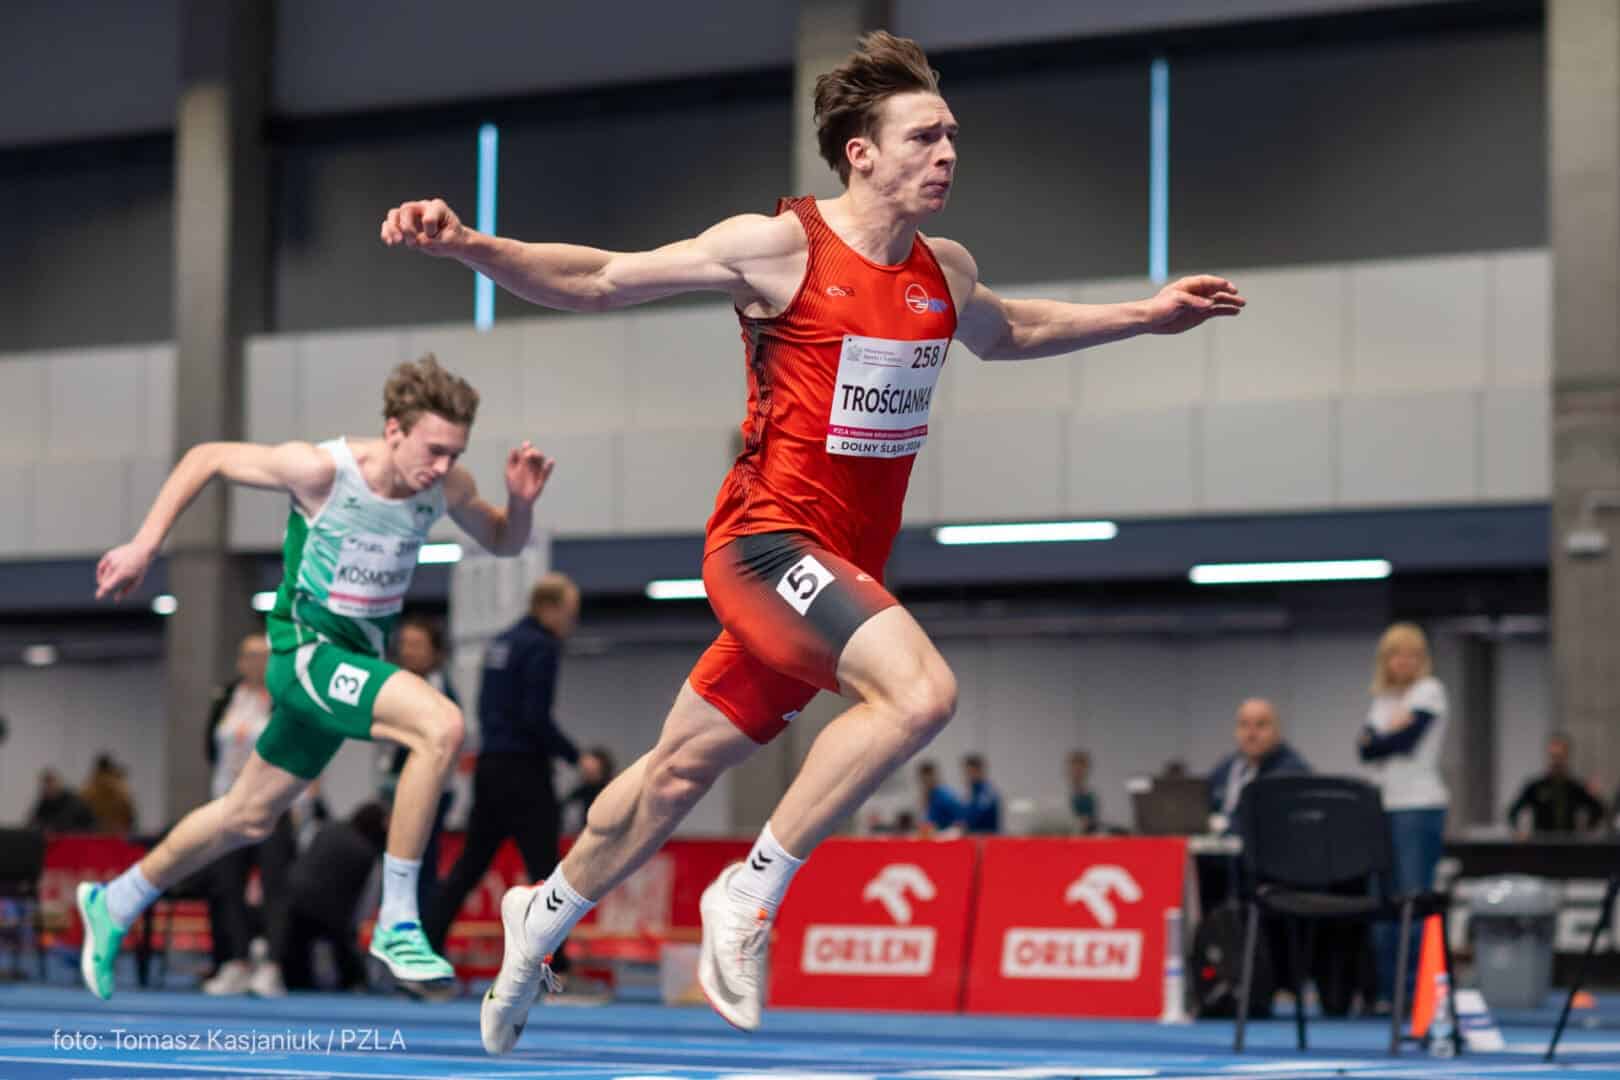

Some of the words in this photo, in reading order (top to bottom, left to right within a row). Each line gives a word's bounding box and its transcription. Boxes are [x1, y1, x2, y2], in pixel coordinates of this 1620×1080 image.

[911, 345, 940, 369] 258
[841, 441, 878, 454] DOLNY
[787, 564, 819, 600] 5
[335, 675, 359, 695] 3
[814, 936, 921, 965] ORLEN
[1014, 938, 1128, 968] ORLEN
